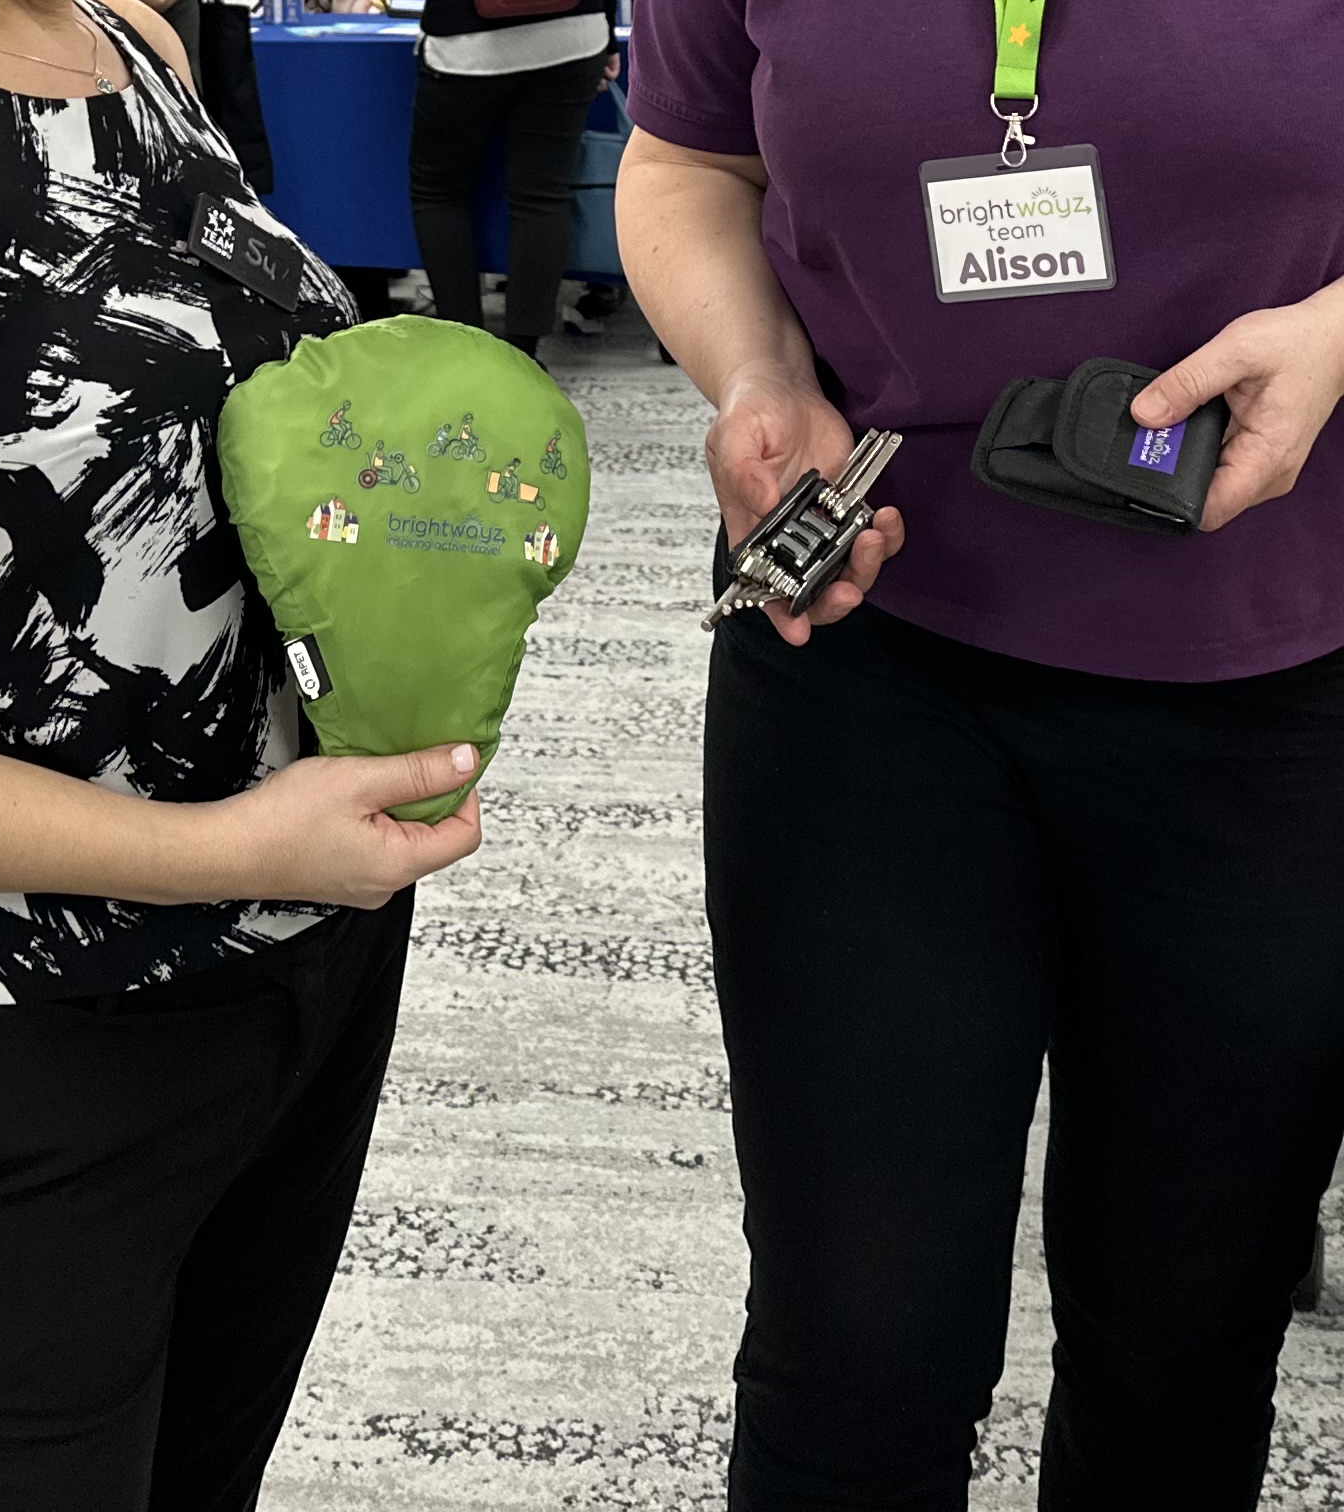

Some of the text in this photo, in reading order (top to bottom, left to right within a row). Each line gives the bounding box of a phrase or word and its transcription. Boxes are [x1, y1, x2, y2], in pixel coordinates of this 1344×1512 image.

[939, 196, 1092, 226] brightwayz
[202, 226, 235, 254] TEAM
[987, 223, 1045, 242] team
[960, 246, 1086, 285] Alison
[388, 513, 506, 544] brightwayz
[385, 536, 501, 555] inspiring active travel
